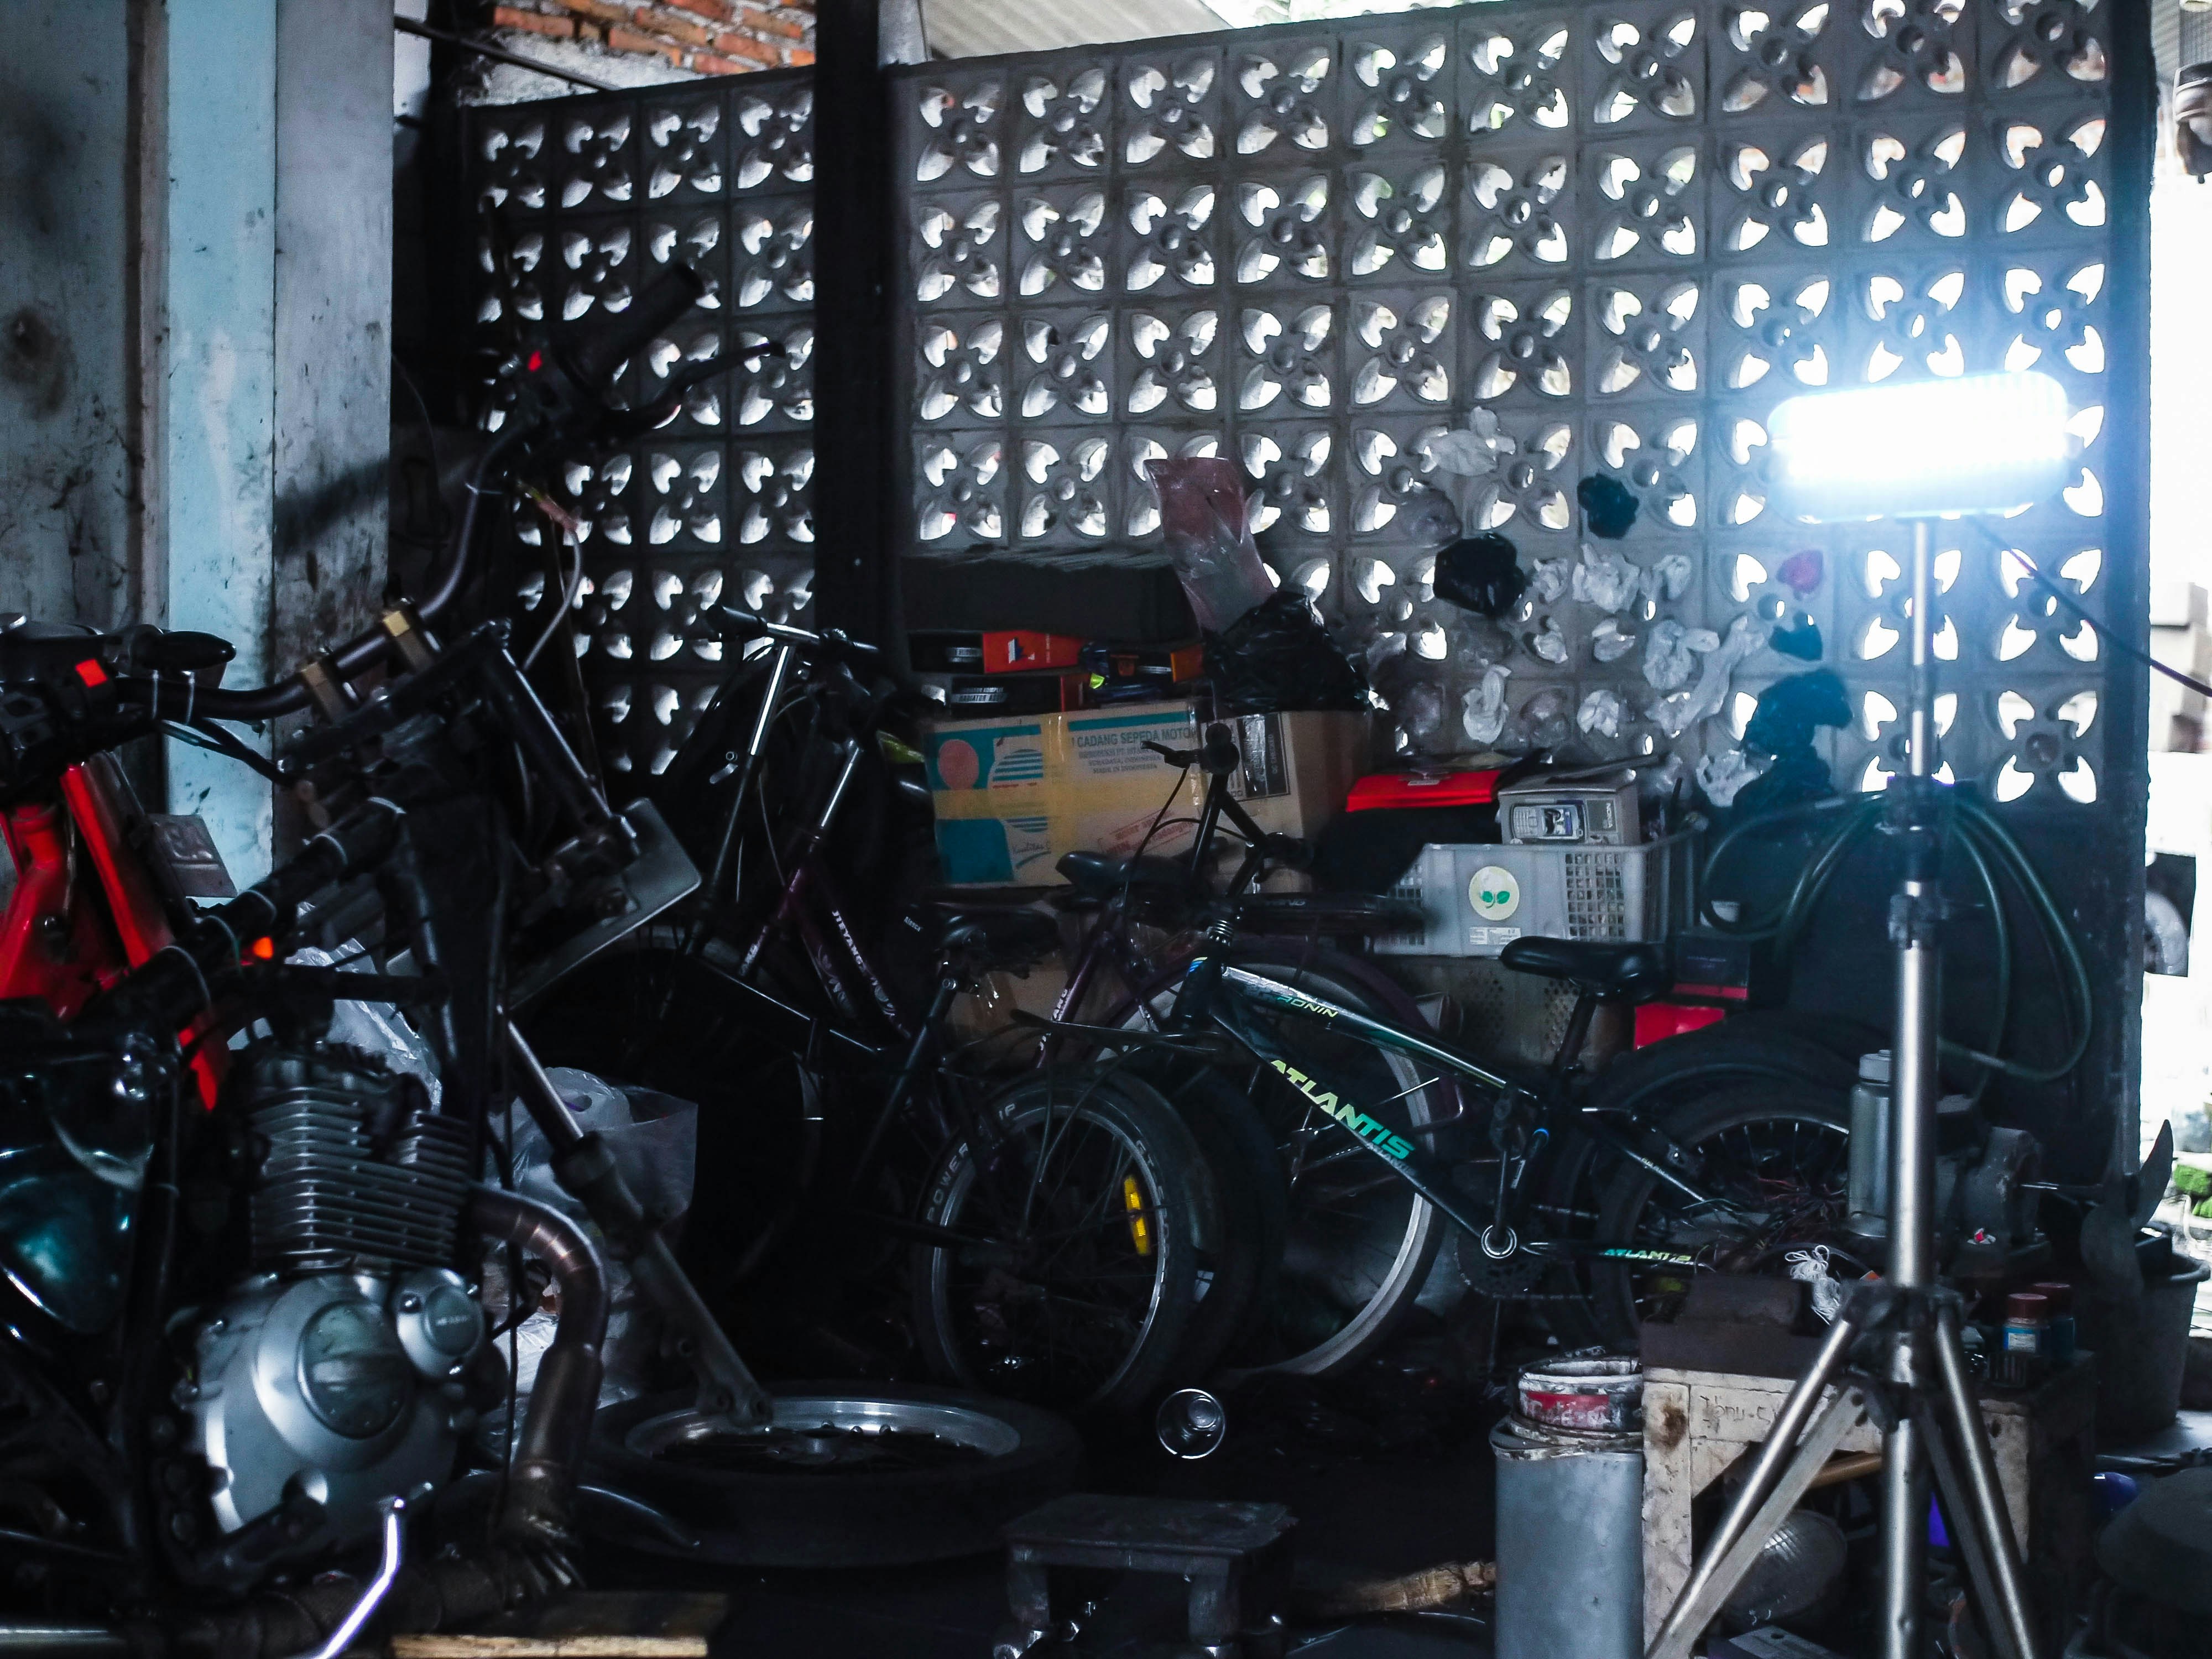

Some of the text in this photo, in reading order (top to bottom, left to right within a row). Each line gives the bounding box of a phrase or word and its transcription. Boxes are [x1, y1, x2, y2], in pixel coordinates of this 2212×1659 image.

[1077, 727, 1196, 747] CADANG SEPEDA MOTOR
[1276, 996, 1338, 1017] RONIN
[1270, 1060, 1415, 1160] ATLANTIS
[1603, 1248, 1693, 1262] ATLANTIS
